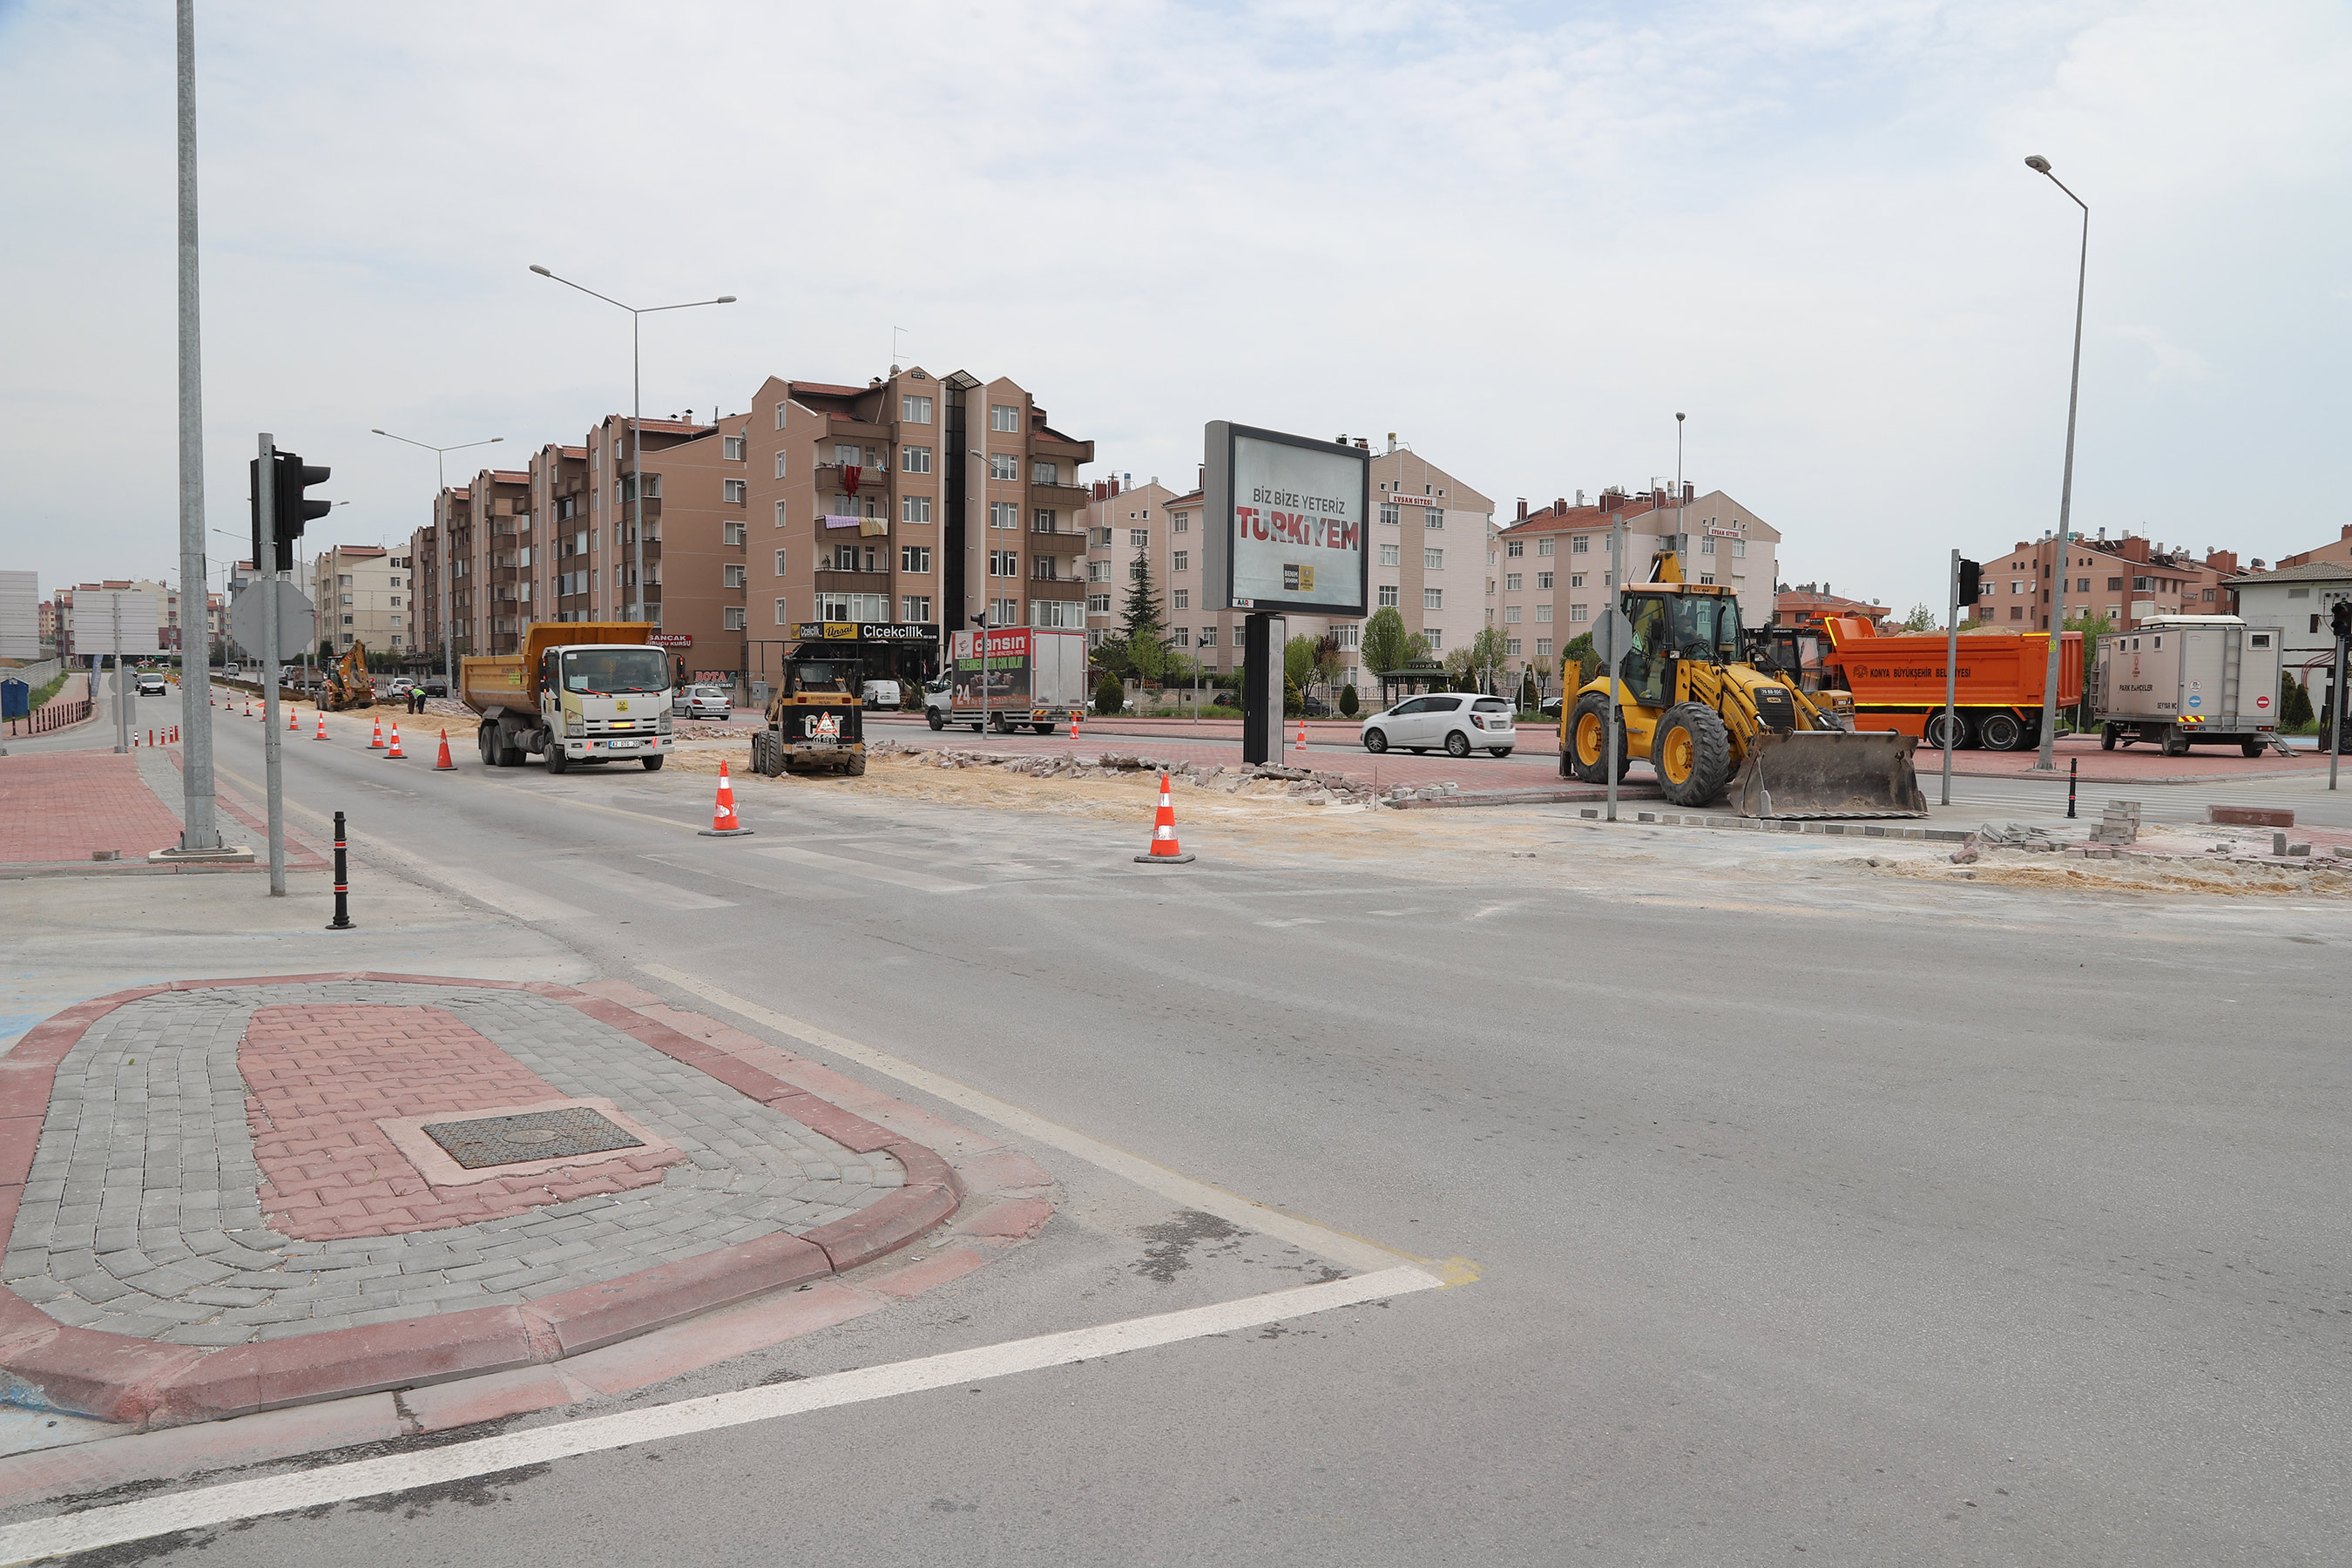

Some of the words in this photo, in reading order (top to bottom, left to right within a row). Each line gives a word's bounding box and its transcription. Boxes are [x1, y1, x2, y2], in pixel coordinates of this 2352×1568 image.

[1253, 485, 1271, 504] BİZ
[1274, 489, 1299, 508] BİZE
[1301, 495, 1345, 514] YETERİZ
[1236, 506, 1359, 551] TÜRKİYEM
[826, 624, 853, 638] Ünsal
[863, 625, 923, 639] Çiçekçilik
[695, 672, 727, 681] ROTA
[1870, 668, 1889, 677] KONYA
[1894, 666, 1931, 679] BÜYÜKŞEHİR
[956, 684, 970, 705] 24
